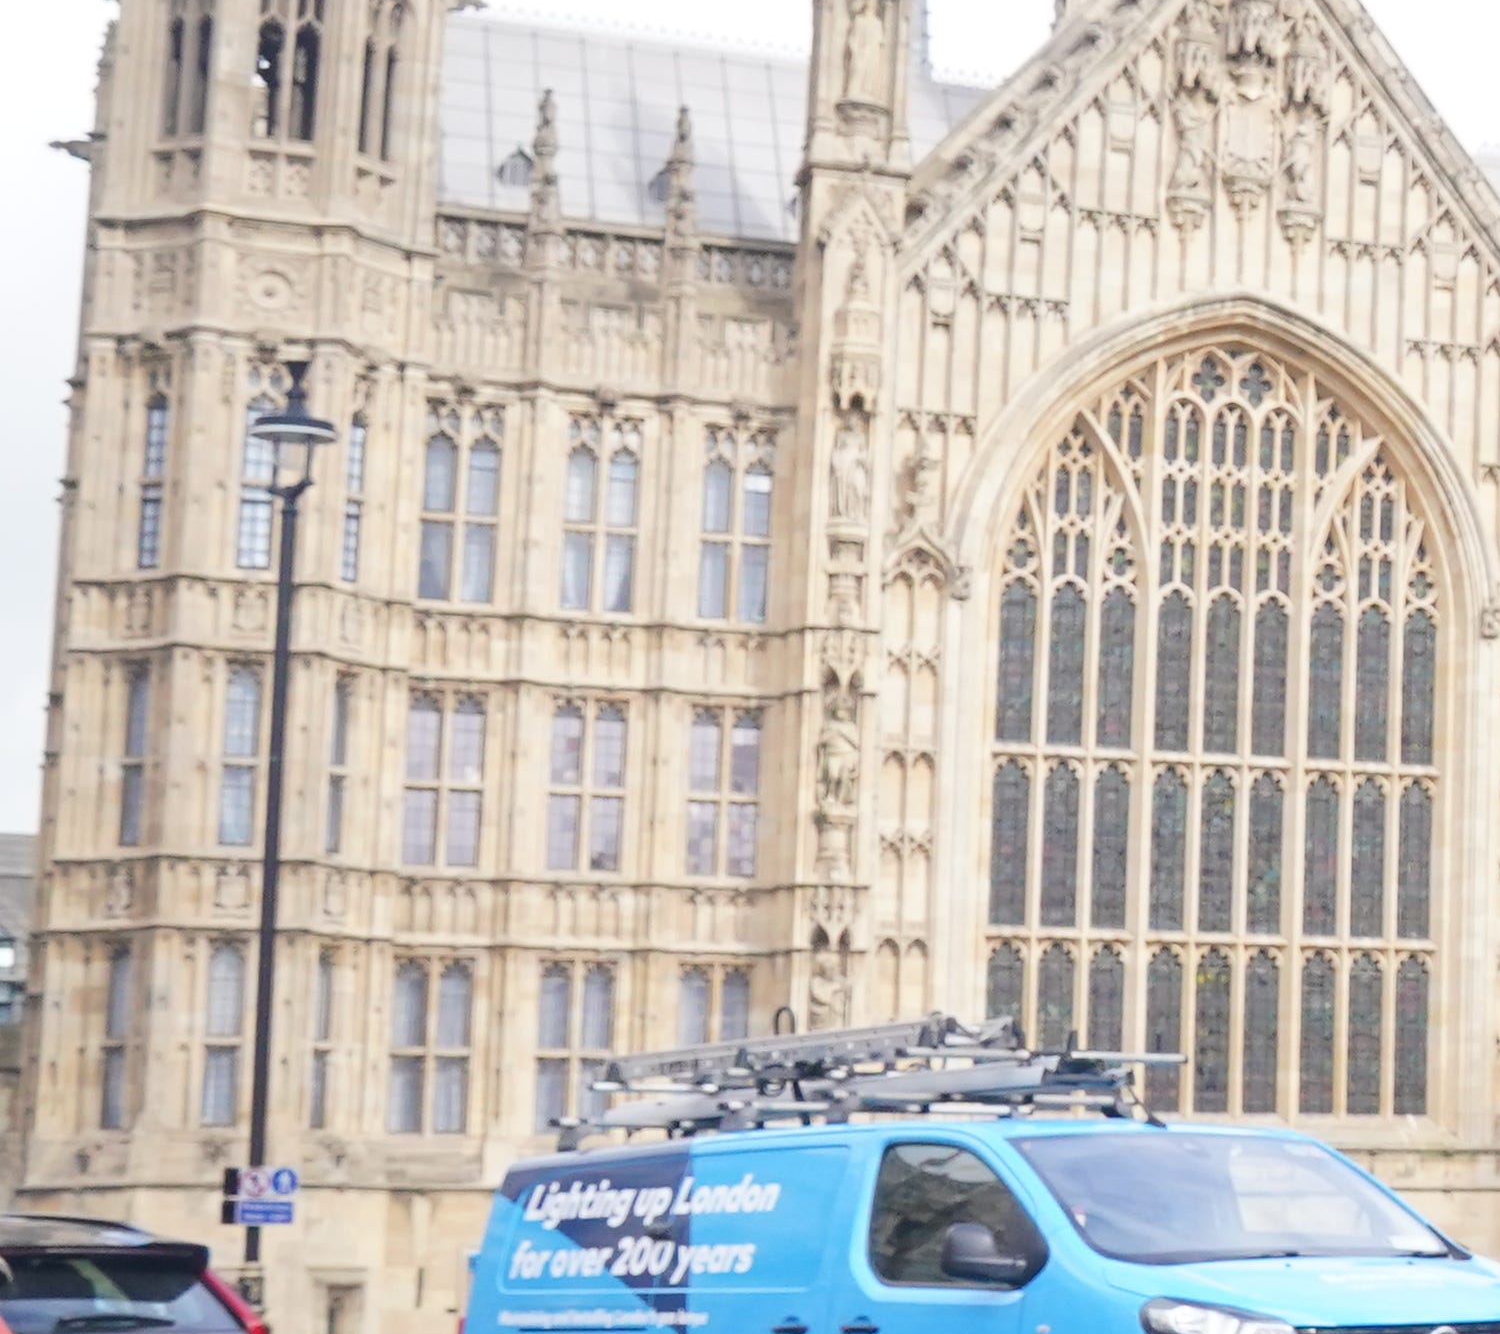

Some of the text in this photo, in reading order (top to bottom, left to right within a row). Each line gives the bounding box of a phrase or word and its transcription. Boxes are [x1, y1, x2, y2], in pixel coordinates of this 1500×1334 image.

[524, 1173, 781, 1230] Lighting up London
[508, 1235, 757, 1285] for over 200 years
